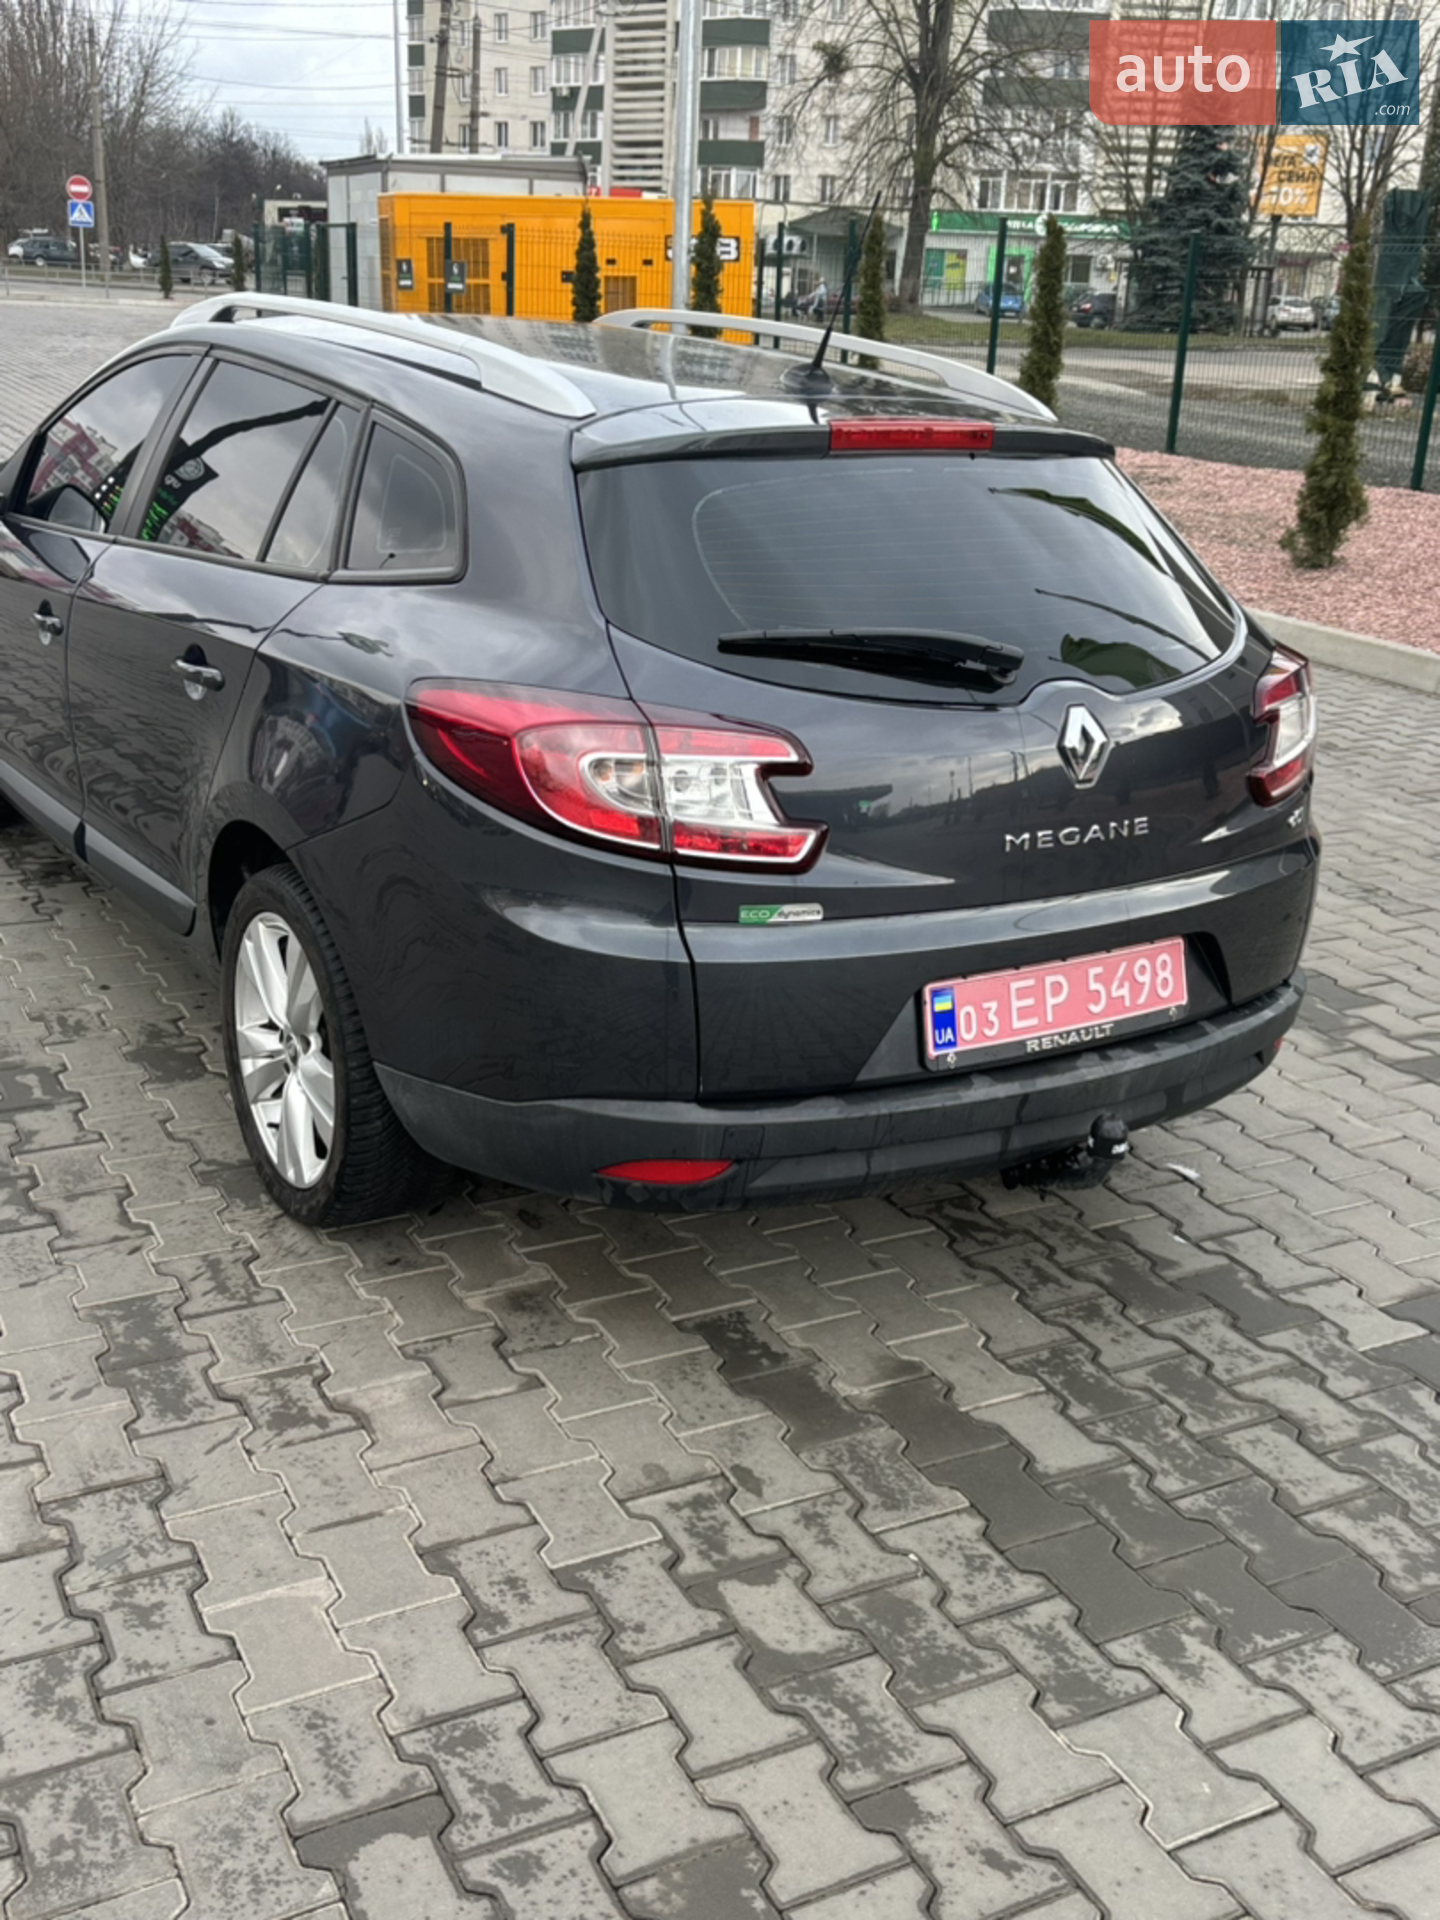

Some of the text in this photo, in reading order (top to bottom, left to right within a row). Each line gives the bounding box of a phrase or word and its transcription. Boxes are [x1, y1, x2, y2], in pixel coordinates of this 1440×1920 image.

[1004, 816, 1149, 852] MEGANE
[740, 909, 771, 919] ECO
[959, 952, 1174, 1042] 03 EP 5498
[935, 1028, 955, 1045] UA
[1025, 1023, 1115, 1053] RENAULT
